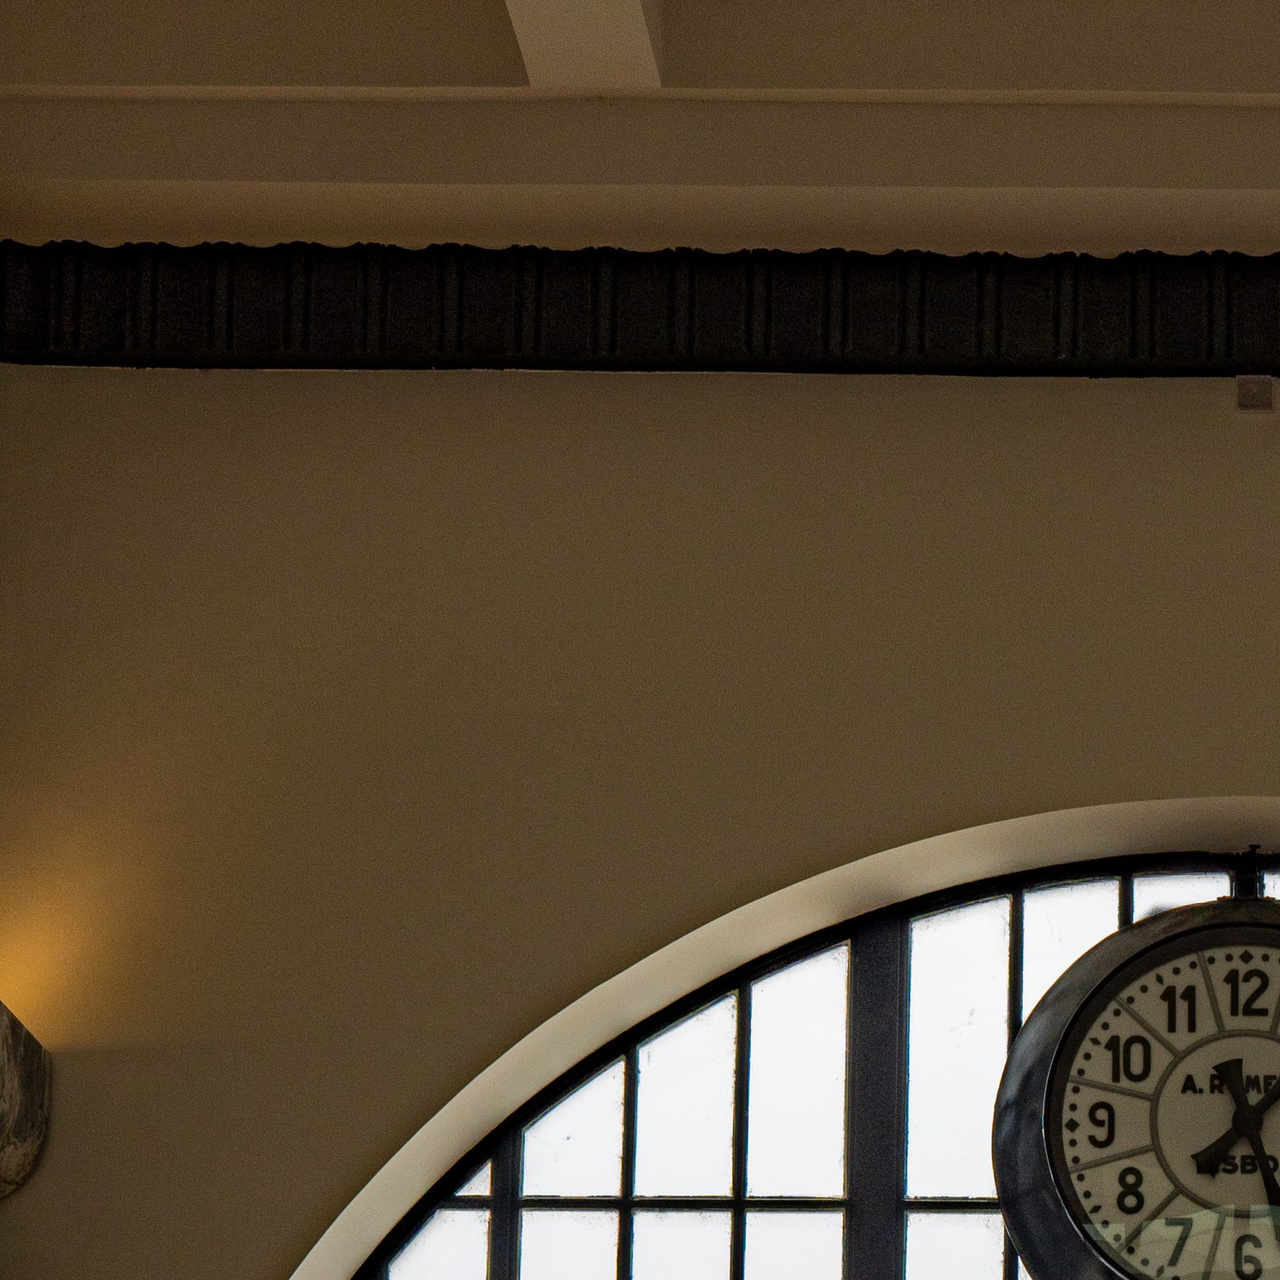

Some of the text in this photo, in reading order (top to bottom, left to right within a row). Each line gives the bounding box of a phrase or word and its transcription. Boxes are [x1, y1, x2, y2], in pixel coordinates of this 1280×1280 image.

[1159, 984, 1197, 1034] 11
[1222, 968, 1270, 1017] 12
[1103, 1034, 1152, 1084] 10
[1180, 1073, 1205, 1095] A.
[1087, 1100, 1116, 1149] 9
[1116, 1166, 1145, 1216] 8
[1164, 1216, 1194, 1267] 7
